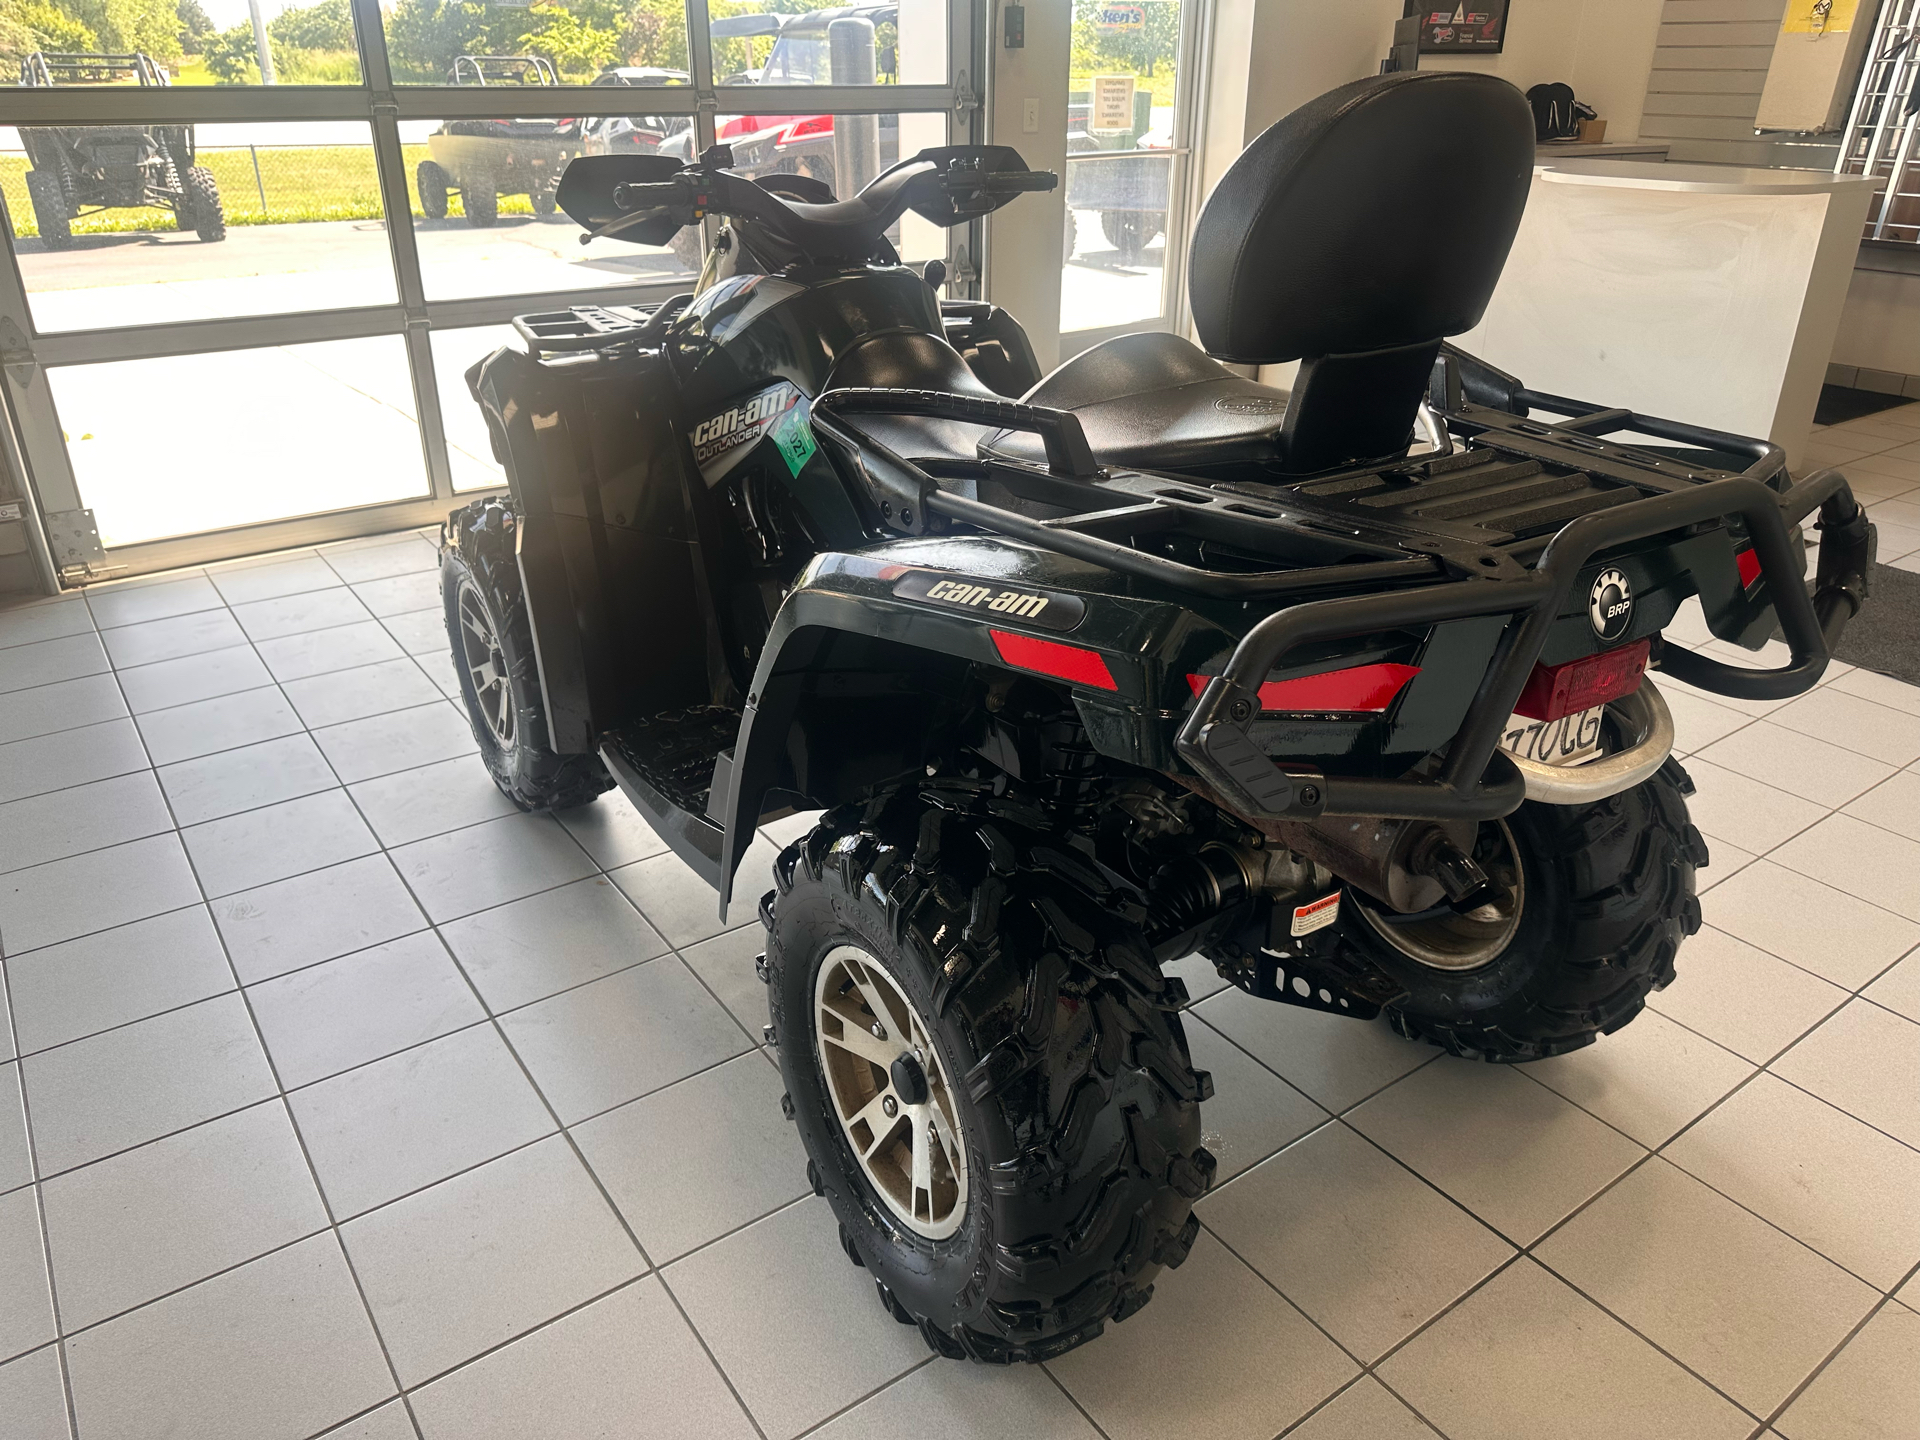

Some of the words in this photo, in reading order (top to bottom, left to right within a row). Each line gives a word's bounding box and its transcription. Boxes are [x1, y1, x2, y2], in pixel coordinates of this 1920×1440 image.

[696, 425, 760, 461] OUTLANDER
[784, 422, 807, 459] 2027
[926, 580, 1049, 618] can-am
[1607, 600, 1630, 618] BRP
[1311, 896, 1338, 912] WARNING
